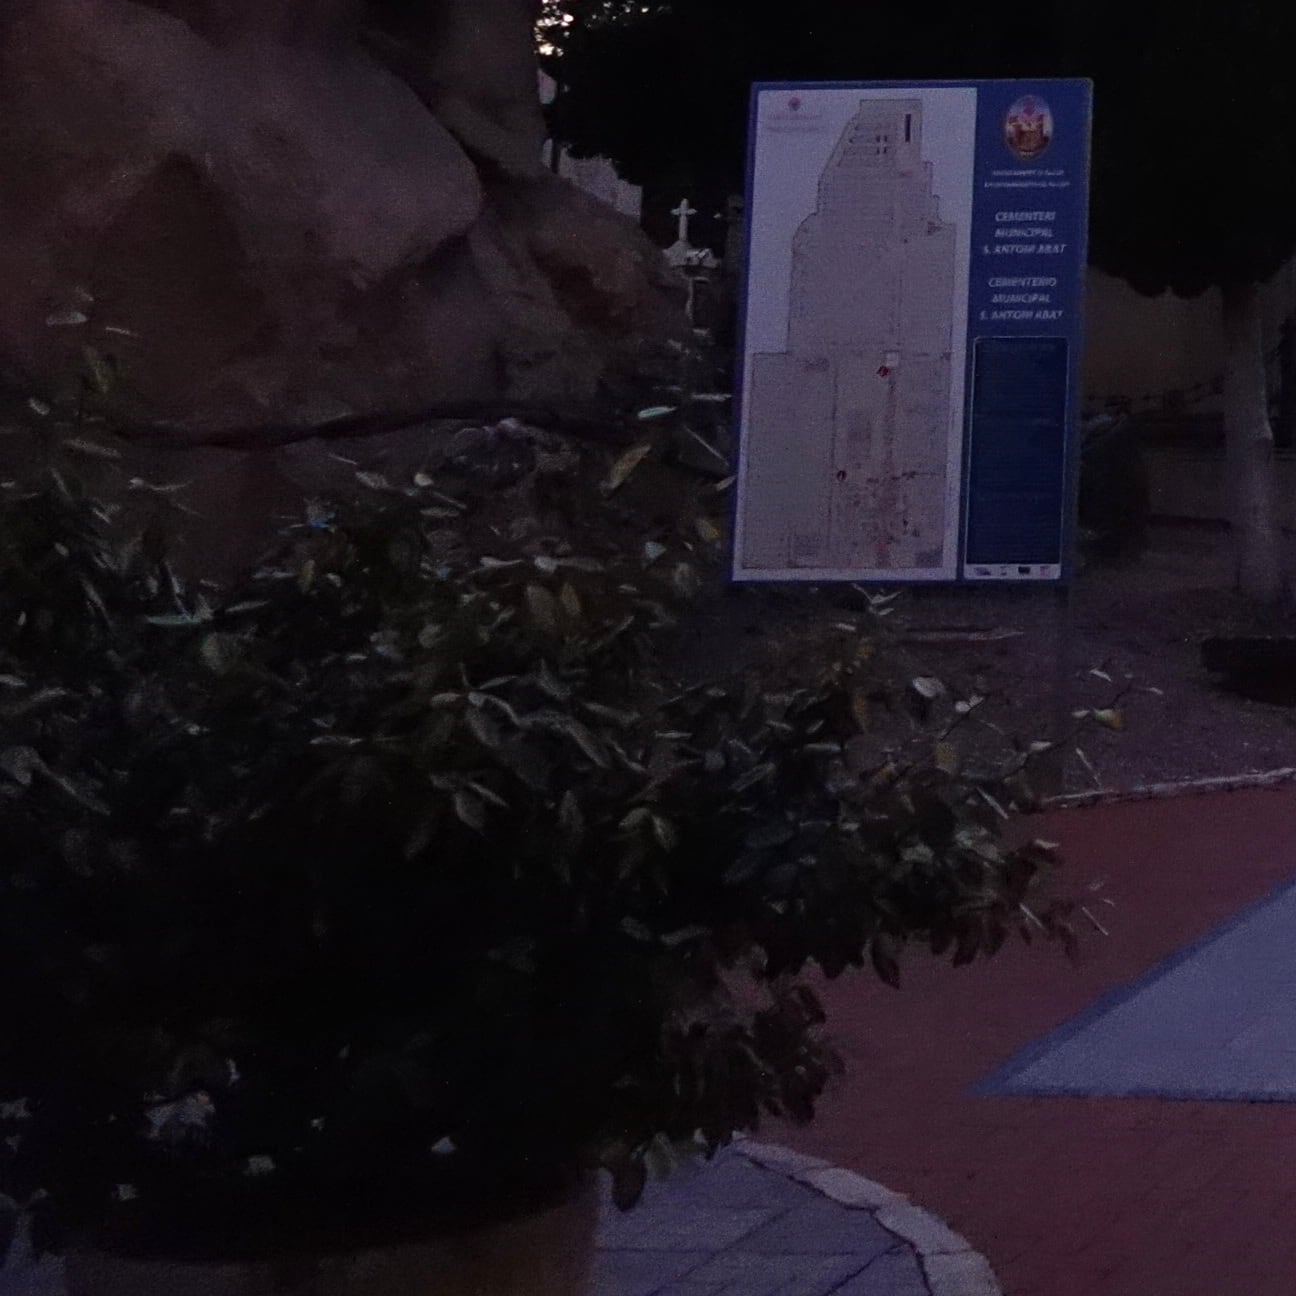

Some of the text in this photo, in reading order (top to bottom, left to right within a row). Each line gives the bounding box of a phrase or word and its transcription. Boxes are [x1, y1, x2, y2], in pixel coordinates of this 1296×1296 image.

[994, 227, 1054, 238] MUNICIPAL
[988, 277, 1057, 287] CEMENTERIO
[992, 293, 1051, 303] MUNICIPAL
